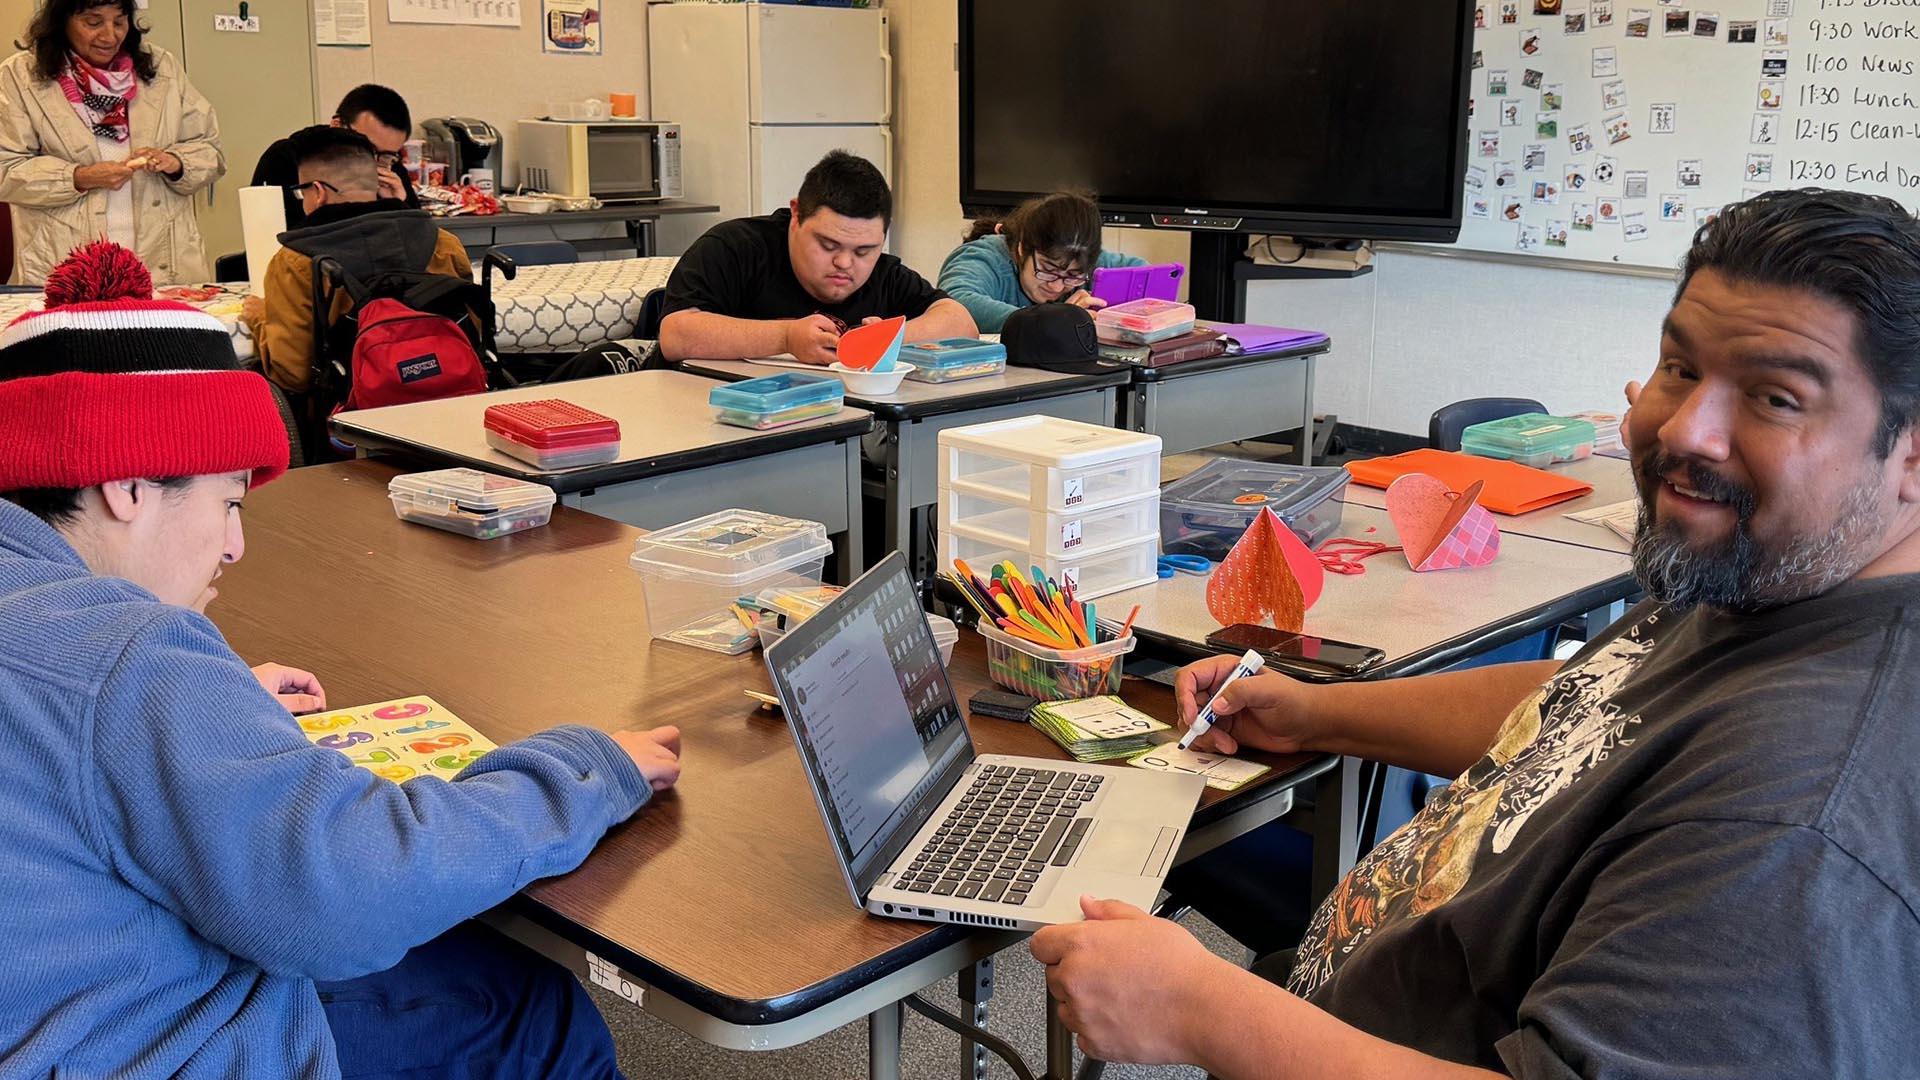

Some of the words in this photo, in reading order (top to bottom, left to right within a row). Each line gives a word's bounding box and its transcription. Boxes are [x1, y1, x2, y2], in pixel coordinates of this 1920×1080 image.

[1809, 19, 1852, 41] 9:30
[1863, 20, 1919, 39] Work
[1806, 53, 1848, 73] 11:00
[1862, 54, 1914, 76] News
[1800, 84, 1840, 107] 11:30
[1854, 87, 1919, 108] Lunch
[1795, 118, 1840, 143] 12:15
[1790, 160, 1836, 180] 12:30
[1845, 161, 1889, 183] End
